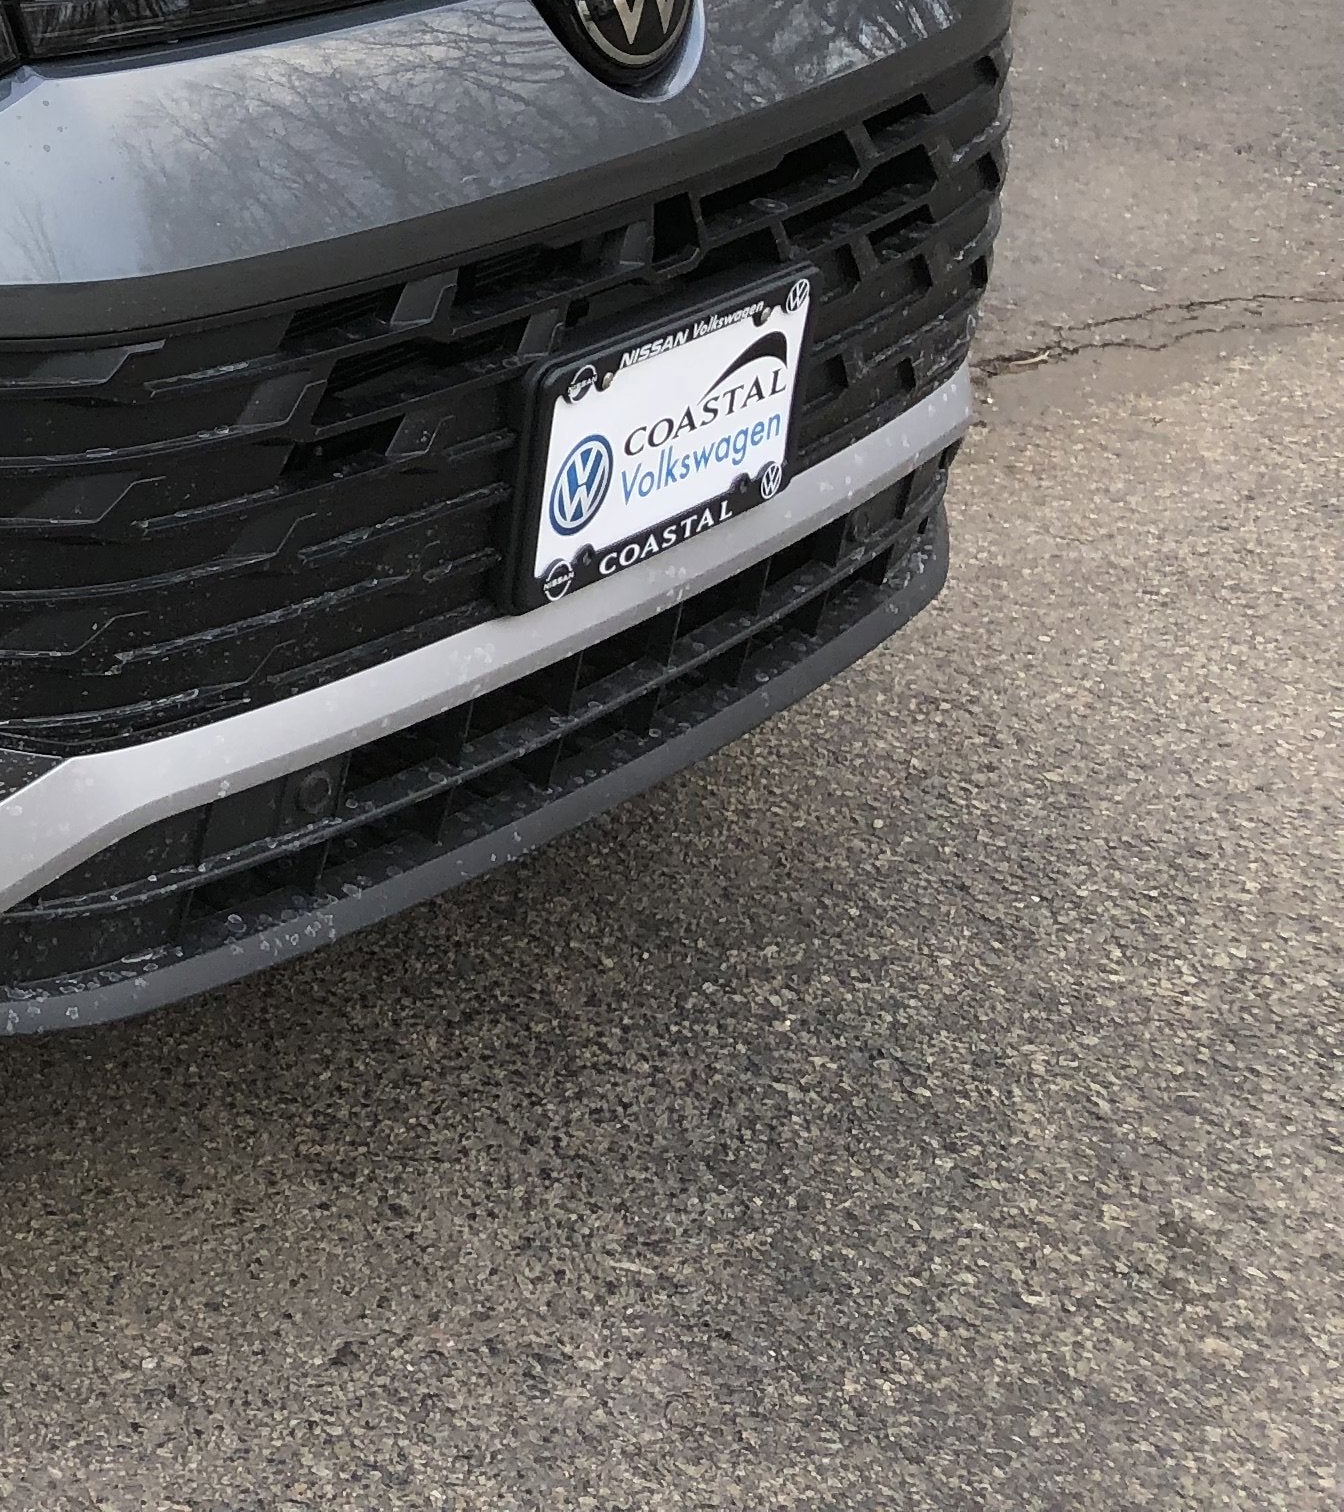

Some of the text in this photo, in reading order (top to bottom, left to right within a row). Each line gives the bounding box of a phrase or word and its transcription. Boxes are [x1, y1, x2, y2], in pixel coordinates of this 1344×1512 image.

[619, 300, 765, 369] NISSAN Volkswagen
[568, 374, 598, 396] NISSAN
[623, 366, 788, 456] COASTAL
[621, 413, 781, 506] Volkswagen
[598, 500, 733, 575] COASTAL
[543, 570, 575, 593] NISSAN
